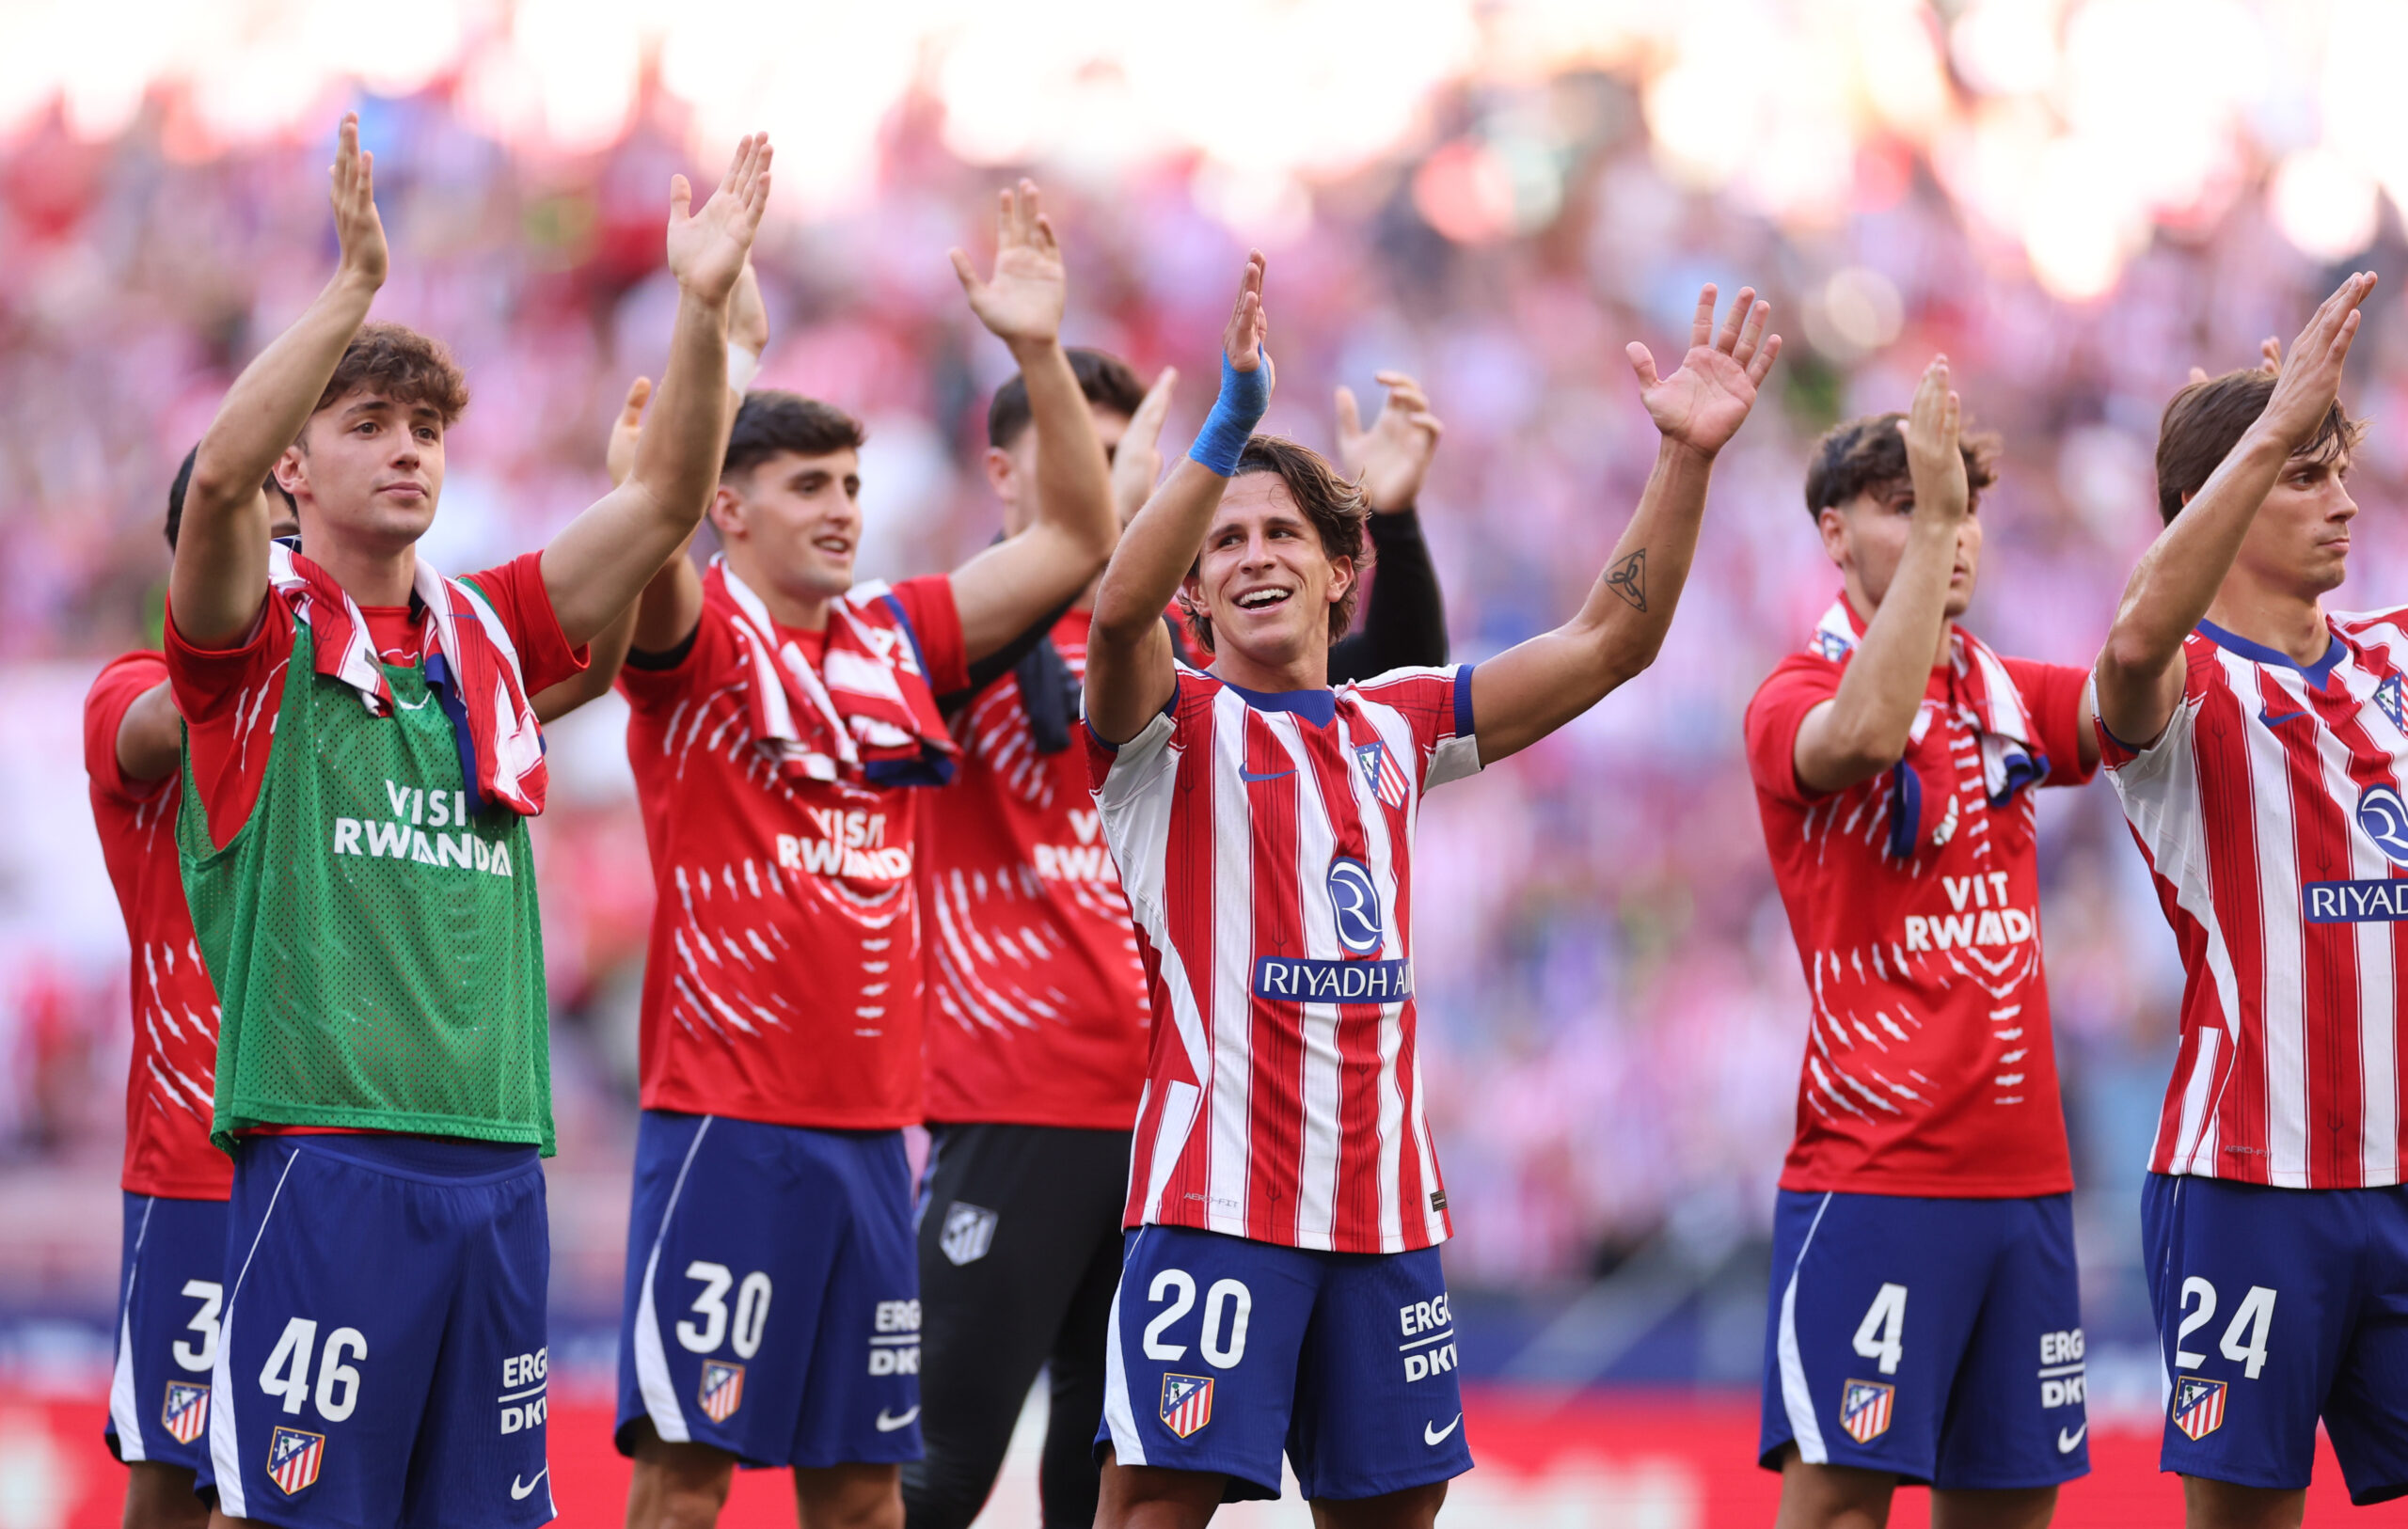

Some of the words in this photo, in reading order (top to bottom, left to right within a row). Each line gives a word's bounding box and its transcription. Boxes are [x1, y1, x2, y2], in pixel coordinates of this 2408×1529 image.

[334, 817, 512, 876] RWANDA
[386, 779, 476, 828] VISI
[1263, 962, 1387, 997] RIYADH
[675, 1260, 772, 1360] 30
[1142, 1269, 1252, 1369] 20
[1851, 1282, 1908, 1375] 4
[2175, 1275, 2277, 1379] 24
[259, 1316, 368, 1423] 46
[503, 1345, 548, 1389] ERG
